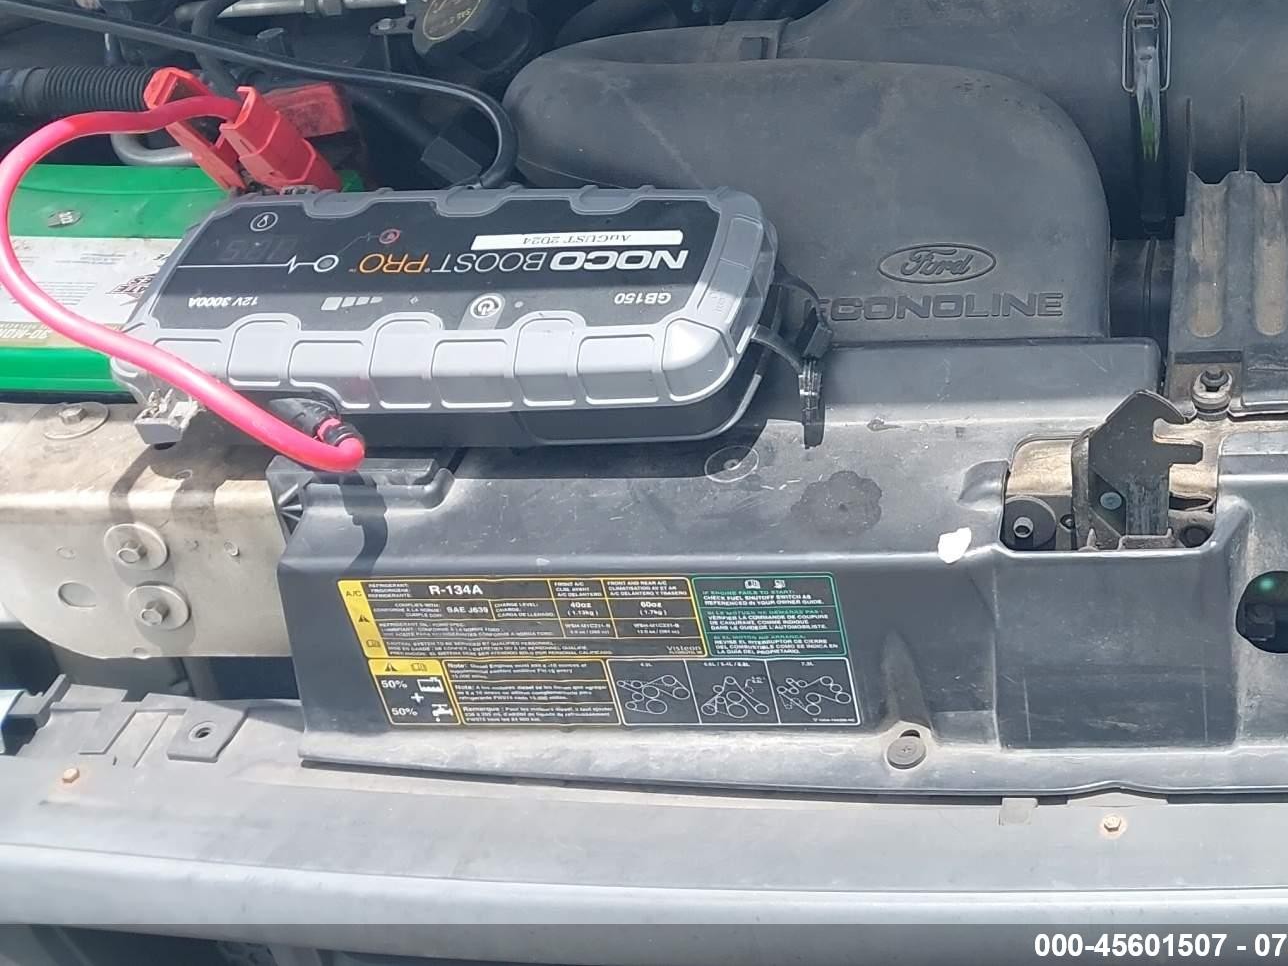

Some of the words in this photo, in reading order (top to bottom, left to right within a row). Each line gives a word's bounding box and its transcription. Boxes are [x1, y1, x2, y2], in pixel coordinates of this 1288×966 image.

[359, 253, 430, 273] PRO
[432, 252, 548, 273] BOOST
[550, 250, 689, 271] NOCO
[900, 248, 974, 276] Ford
[188, 296, 232, 308] 3000A
[232, 296, 259, 306] 12V
[614, 292, 672, 305] GB150
[428, 585, 484, 595] R-134A
[468, 606, 489, 614] J639
[381, 679, 408, 689] 50%
[391, 707, 418, 716] 50%
